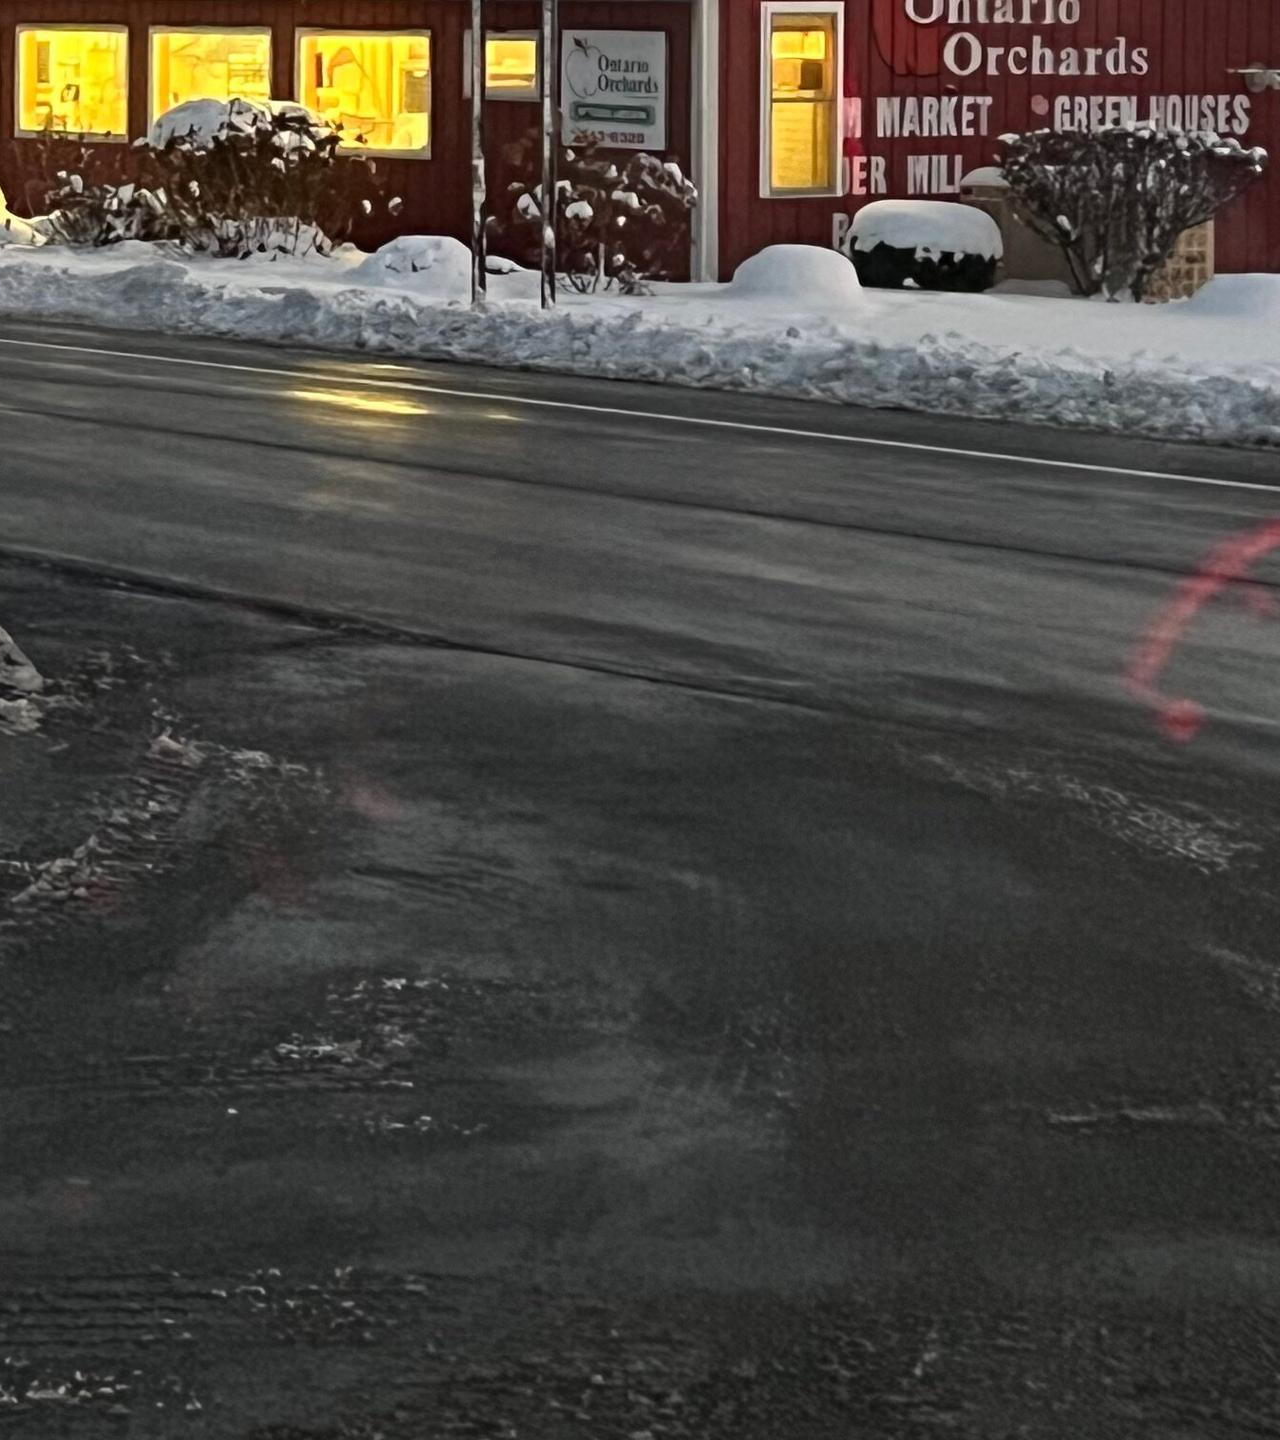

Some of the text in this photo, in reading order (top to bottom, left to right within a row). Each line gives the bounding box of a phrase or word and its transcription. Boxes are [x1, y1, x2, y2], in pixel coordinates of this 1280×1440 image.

[598, 54, 649, 73] Ontario
[943, 31, 1149, 76] Orchards
[598, 73, 659, 94] Orchards
[877, 95, 993, 138] MARKET
[1054, 95, 1138, 134] GREEN
[1149, 94, 1252, 136] HOUSES
